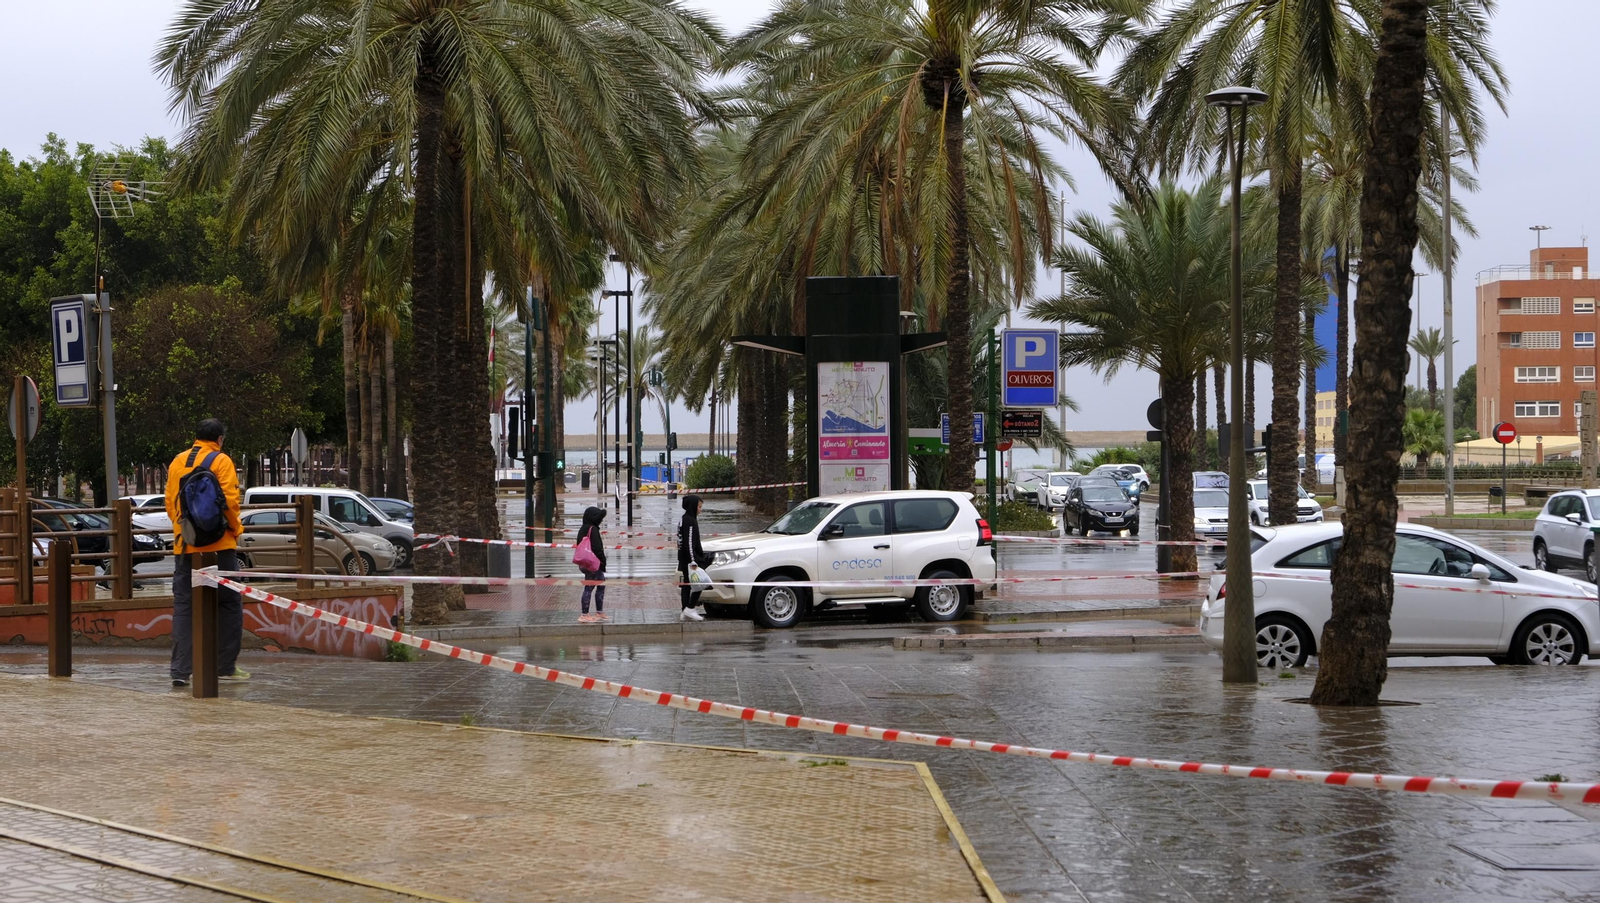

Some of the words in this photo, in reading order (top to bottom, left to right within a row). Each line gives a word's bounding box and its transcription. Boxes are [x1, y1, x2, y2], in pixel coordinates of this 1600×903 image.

[58, 309, 80, 362] P
[1015, 336, 1047, 368] P
[1008, 374, 1052, 385] OLIVEROS
[832, 558, 882, 571] endesa
